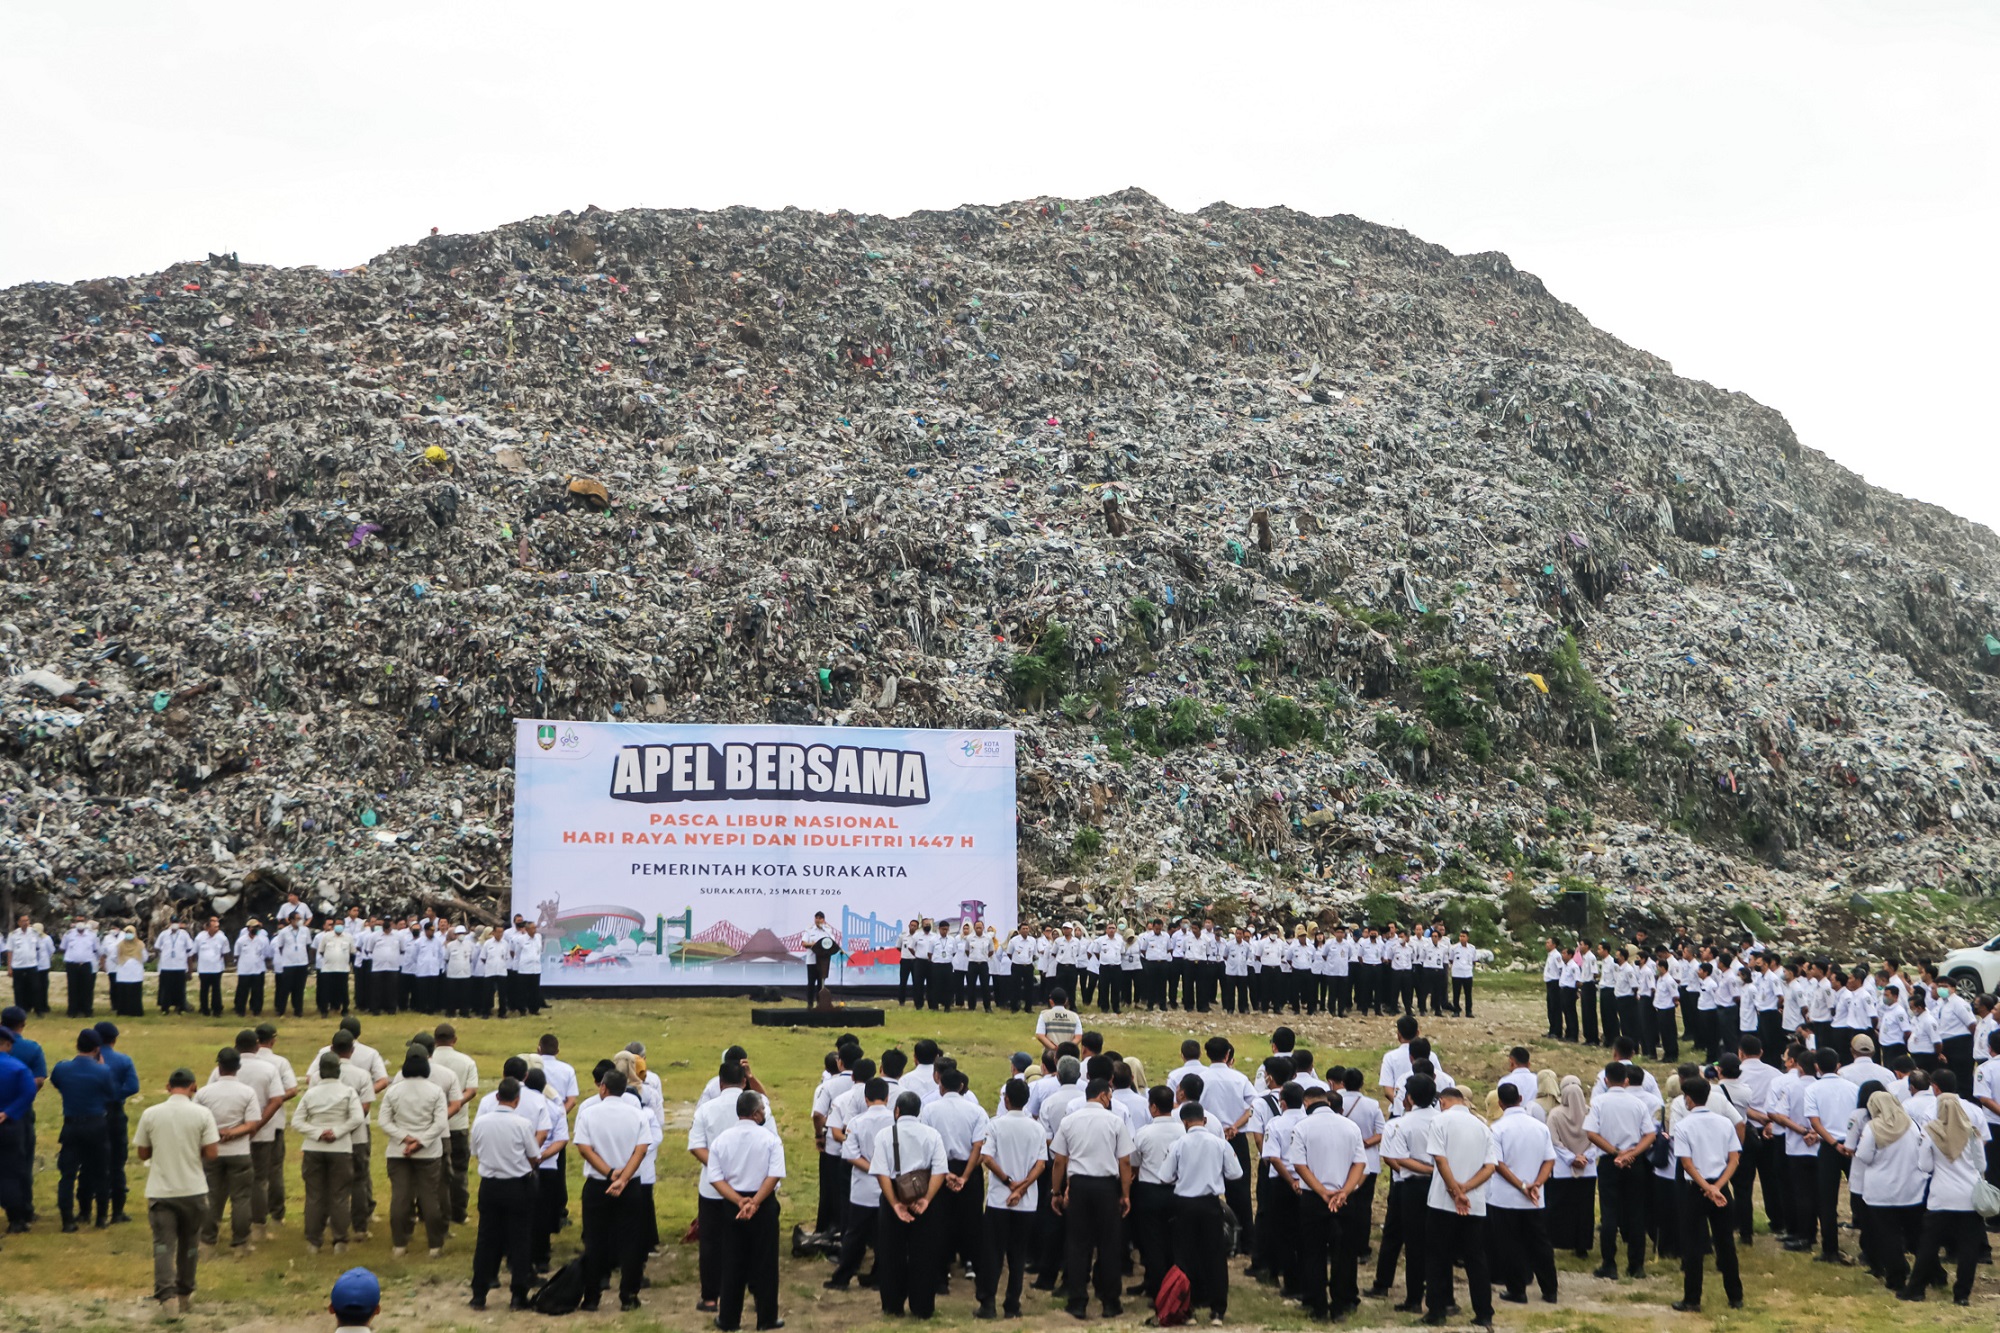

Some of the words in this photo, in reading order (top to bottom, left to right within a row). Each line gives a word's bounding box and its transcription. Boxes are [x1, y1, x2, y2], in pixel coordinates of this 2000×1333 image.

[613, 745, 715, 794] APEL
[725, 745, 926, 799] BERSAMA
[650, 813, 719, 826] PASCA
[726, 815, 787, 827] LIBUR
[794, 815, 899, 829] NASIONAL
[563, 831, 615, 844] HARI
[622, 832, 677, 845] RAYA
[685, 833, 745, 846] NYEPI
[753, 834, 796, 846] DAN
[803, 834, 903, 848] IDULFITRI
[909, 835, 954, 848] 1447
[960, 836, 974, 848] H
[631, 863, 746, 876] PEMERINTAH
[752, 864, 798, 877] KOTA
[802, 864, 908, 878] SURAKARTA
[700, 887, 767, 896] SURAKARTA,
[769, 888, 780, 896] 25
[782, 888, 817, 896] MARET
[820, 888, 842, 896] 2026
